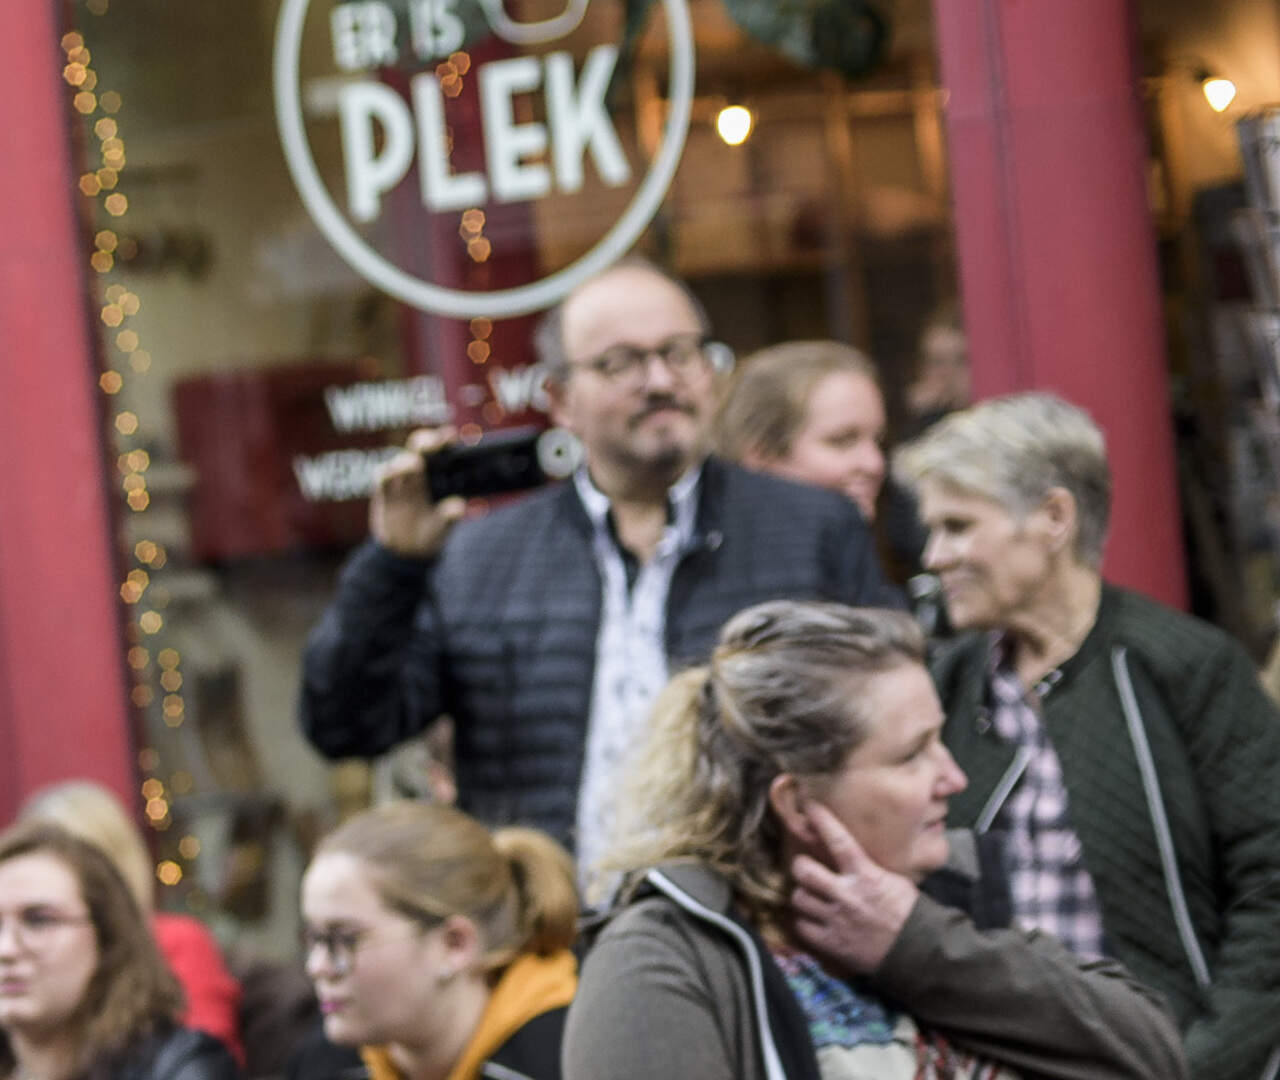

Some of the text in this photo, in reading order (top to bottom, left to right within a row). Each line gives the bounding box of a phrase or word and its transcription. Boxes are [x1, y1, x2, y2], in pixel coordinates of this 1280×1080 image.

[330, 0, 465, 71] ER IS
[340, 44, 632, 223] PLEK
